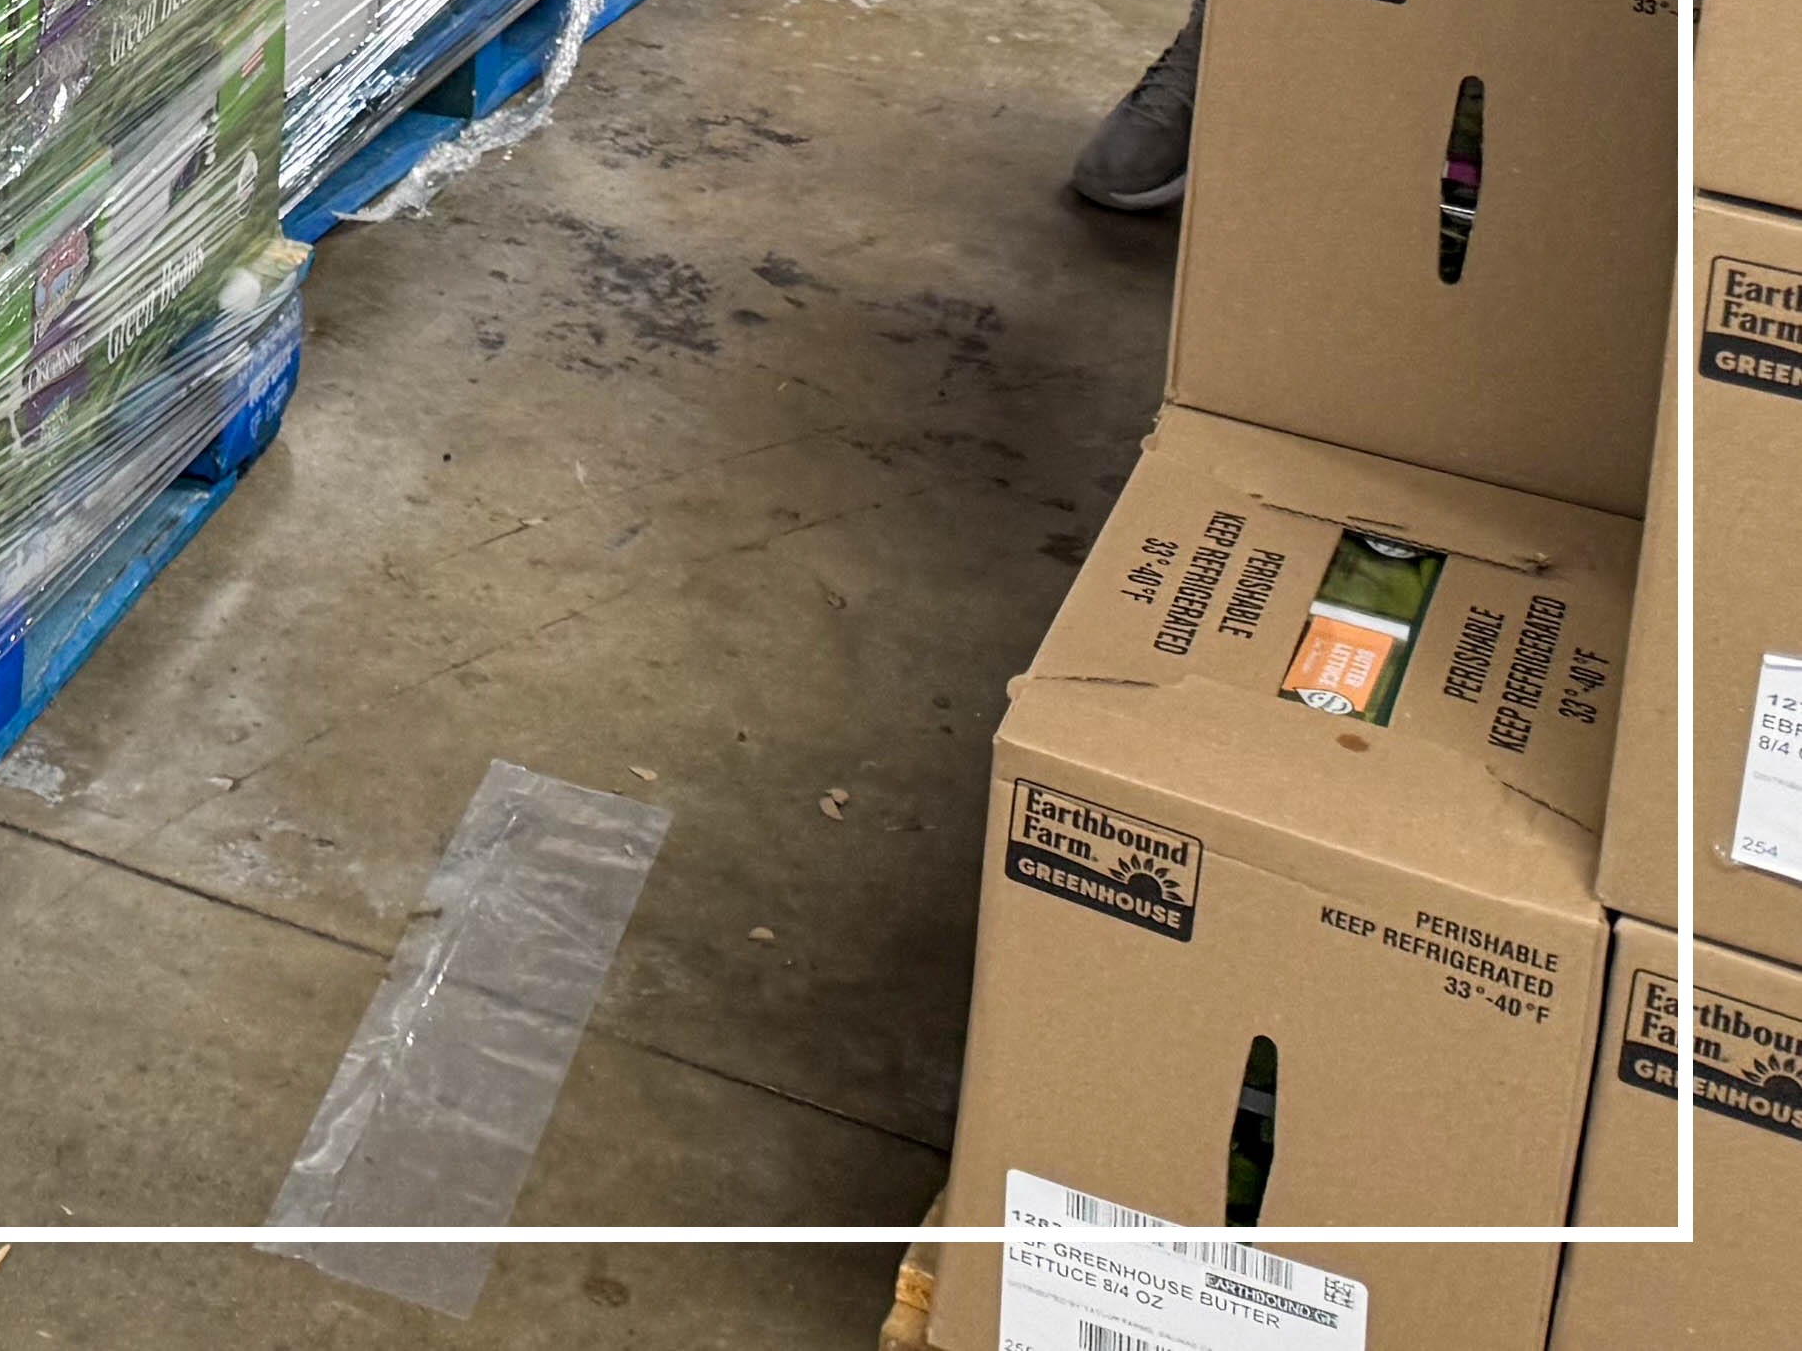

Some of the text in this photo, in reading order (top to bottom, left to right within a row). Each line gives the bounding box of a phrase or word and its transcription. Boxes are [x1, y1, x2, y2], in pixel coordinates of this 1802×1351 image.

[1153, 510, 1247, 655] KEEP REFRIGERATED
[1218, 549, 1285, 639] PERISHABLE
[1318, 643, 1354, 689] LETTUCE
[1444, 606, 1505, 704] PERISHABLE
[1488, 595, 1566, 754] KEEP REFRIGERATED
[1758, 735, 1791, 756] 8/4
[1025, 792, 1189, 865] Earthbound
[1743, 837, 1778, 857] 254
[1017, 855, 1182, 928] GREENHOUSE
[1319, 906, 1554, 999] KEEP REFRIGERATED
[1416, 911, 1559, 972] PERISHABLE
[1009, 1247, 1165, 1311] LETTUCE 8/4 OZ
[1054, 1243, 1282, 1329] GREENHOUSE BUTTER
